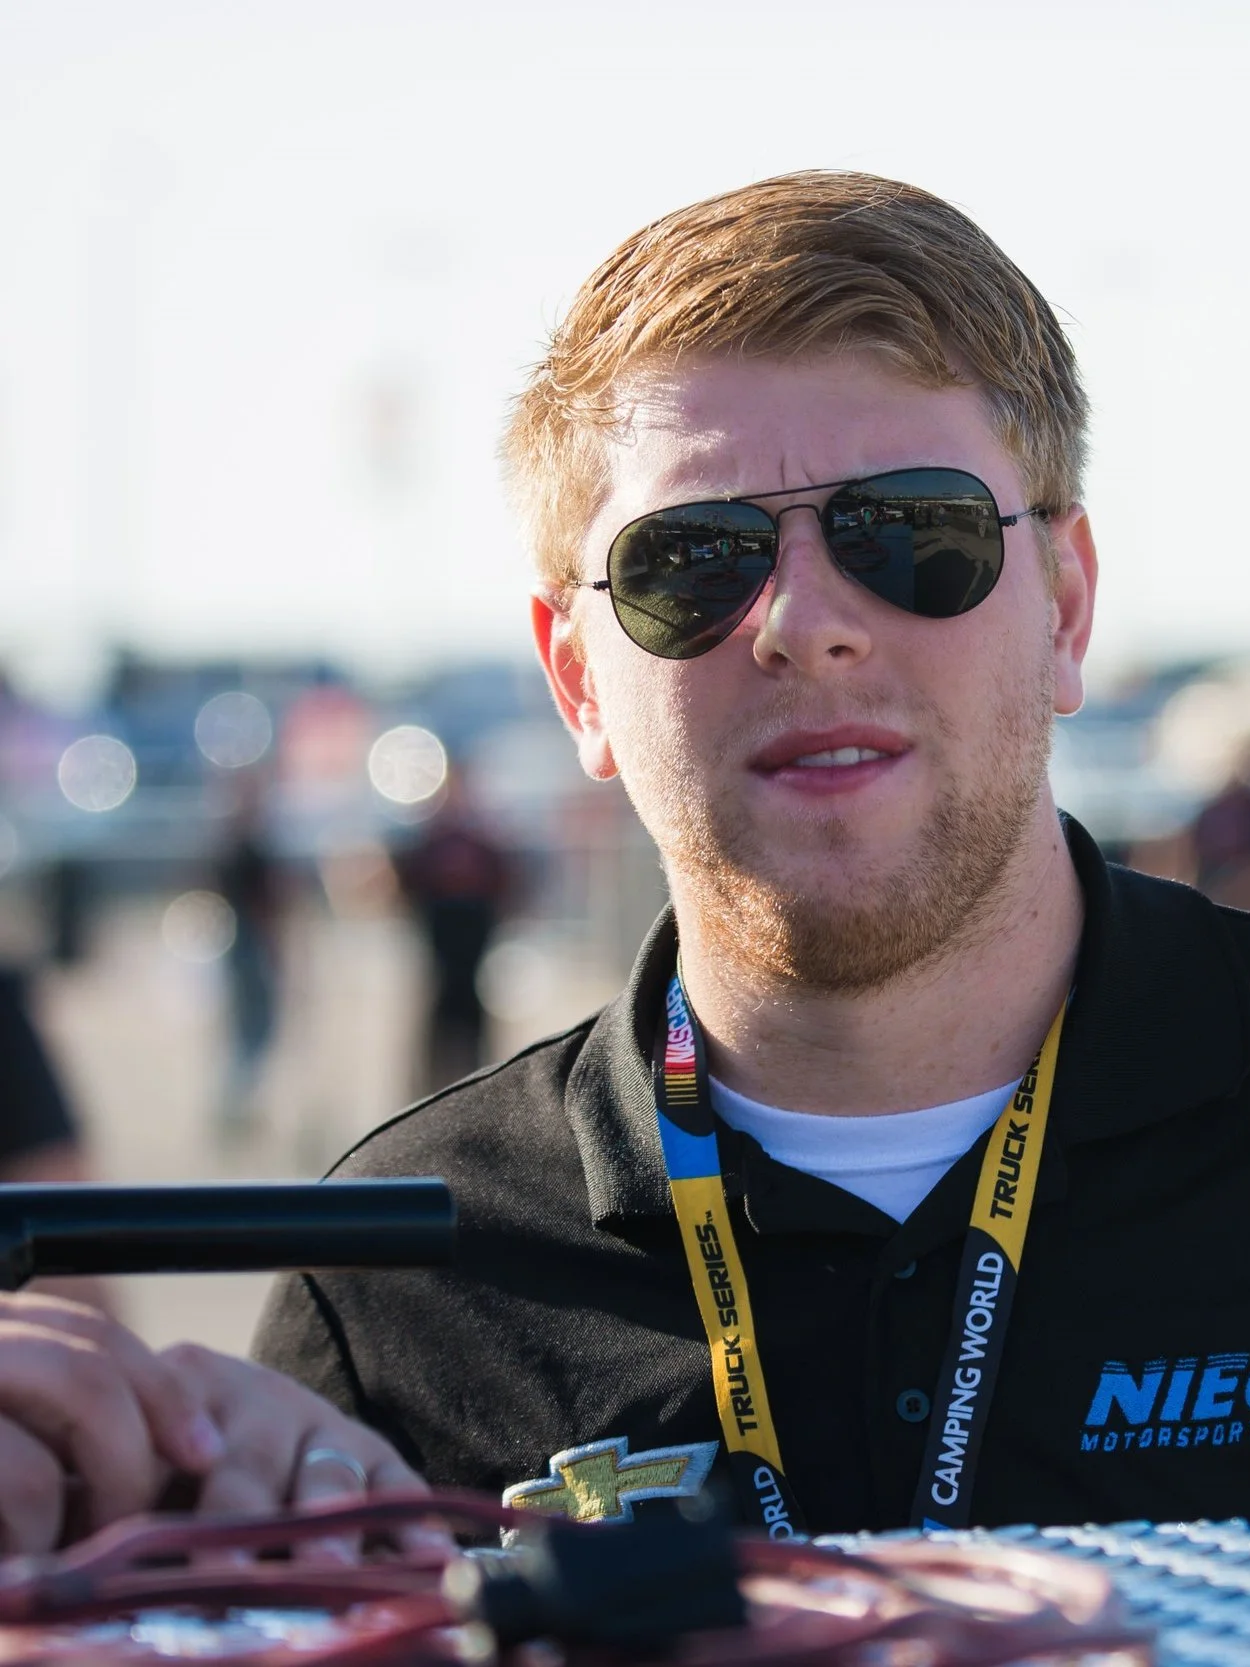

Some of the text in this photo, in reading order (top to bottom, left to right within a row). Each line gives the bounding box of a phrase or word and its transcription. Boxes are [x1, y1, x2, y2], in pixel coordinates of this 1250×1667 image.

[989, 1119, 1030, 1219] TRUCK
[722, 1334, 758, 1437] TRUCK
[931, 1251, 1004, 1506] CAMPING WORLD
[754, 1466, 794, 1541] ORLD
